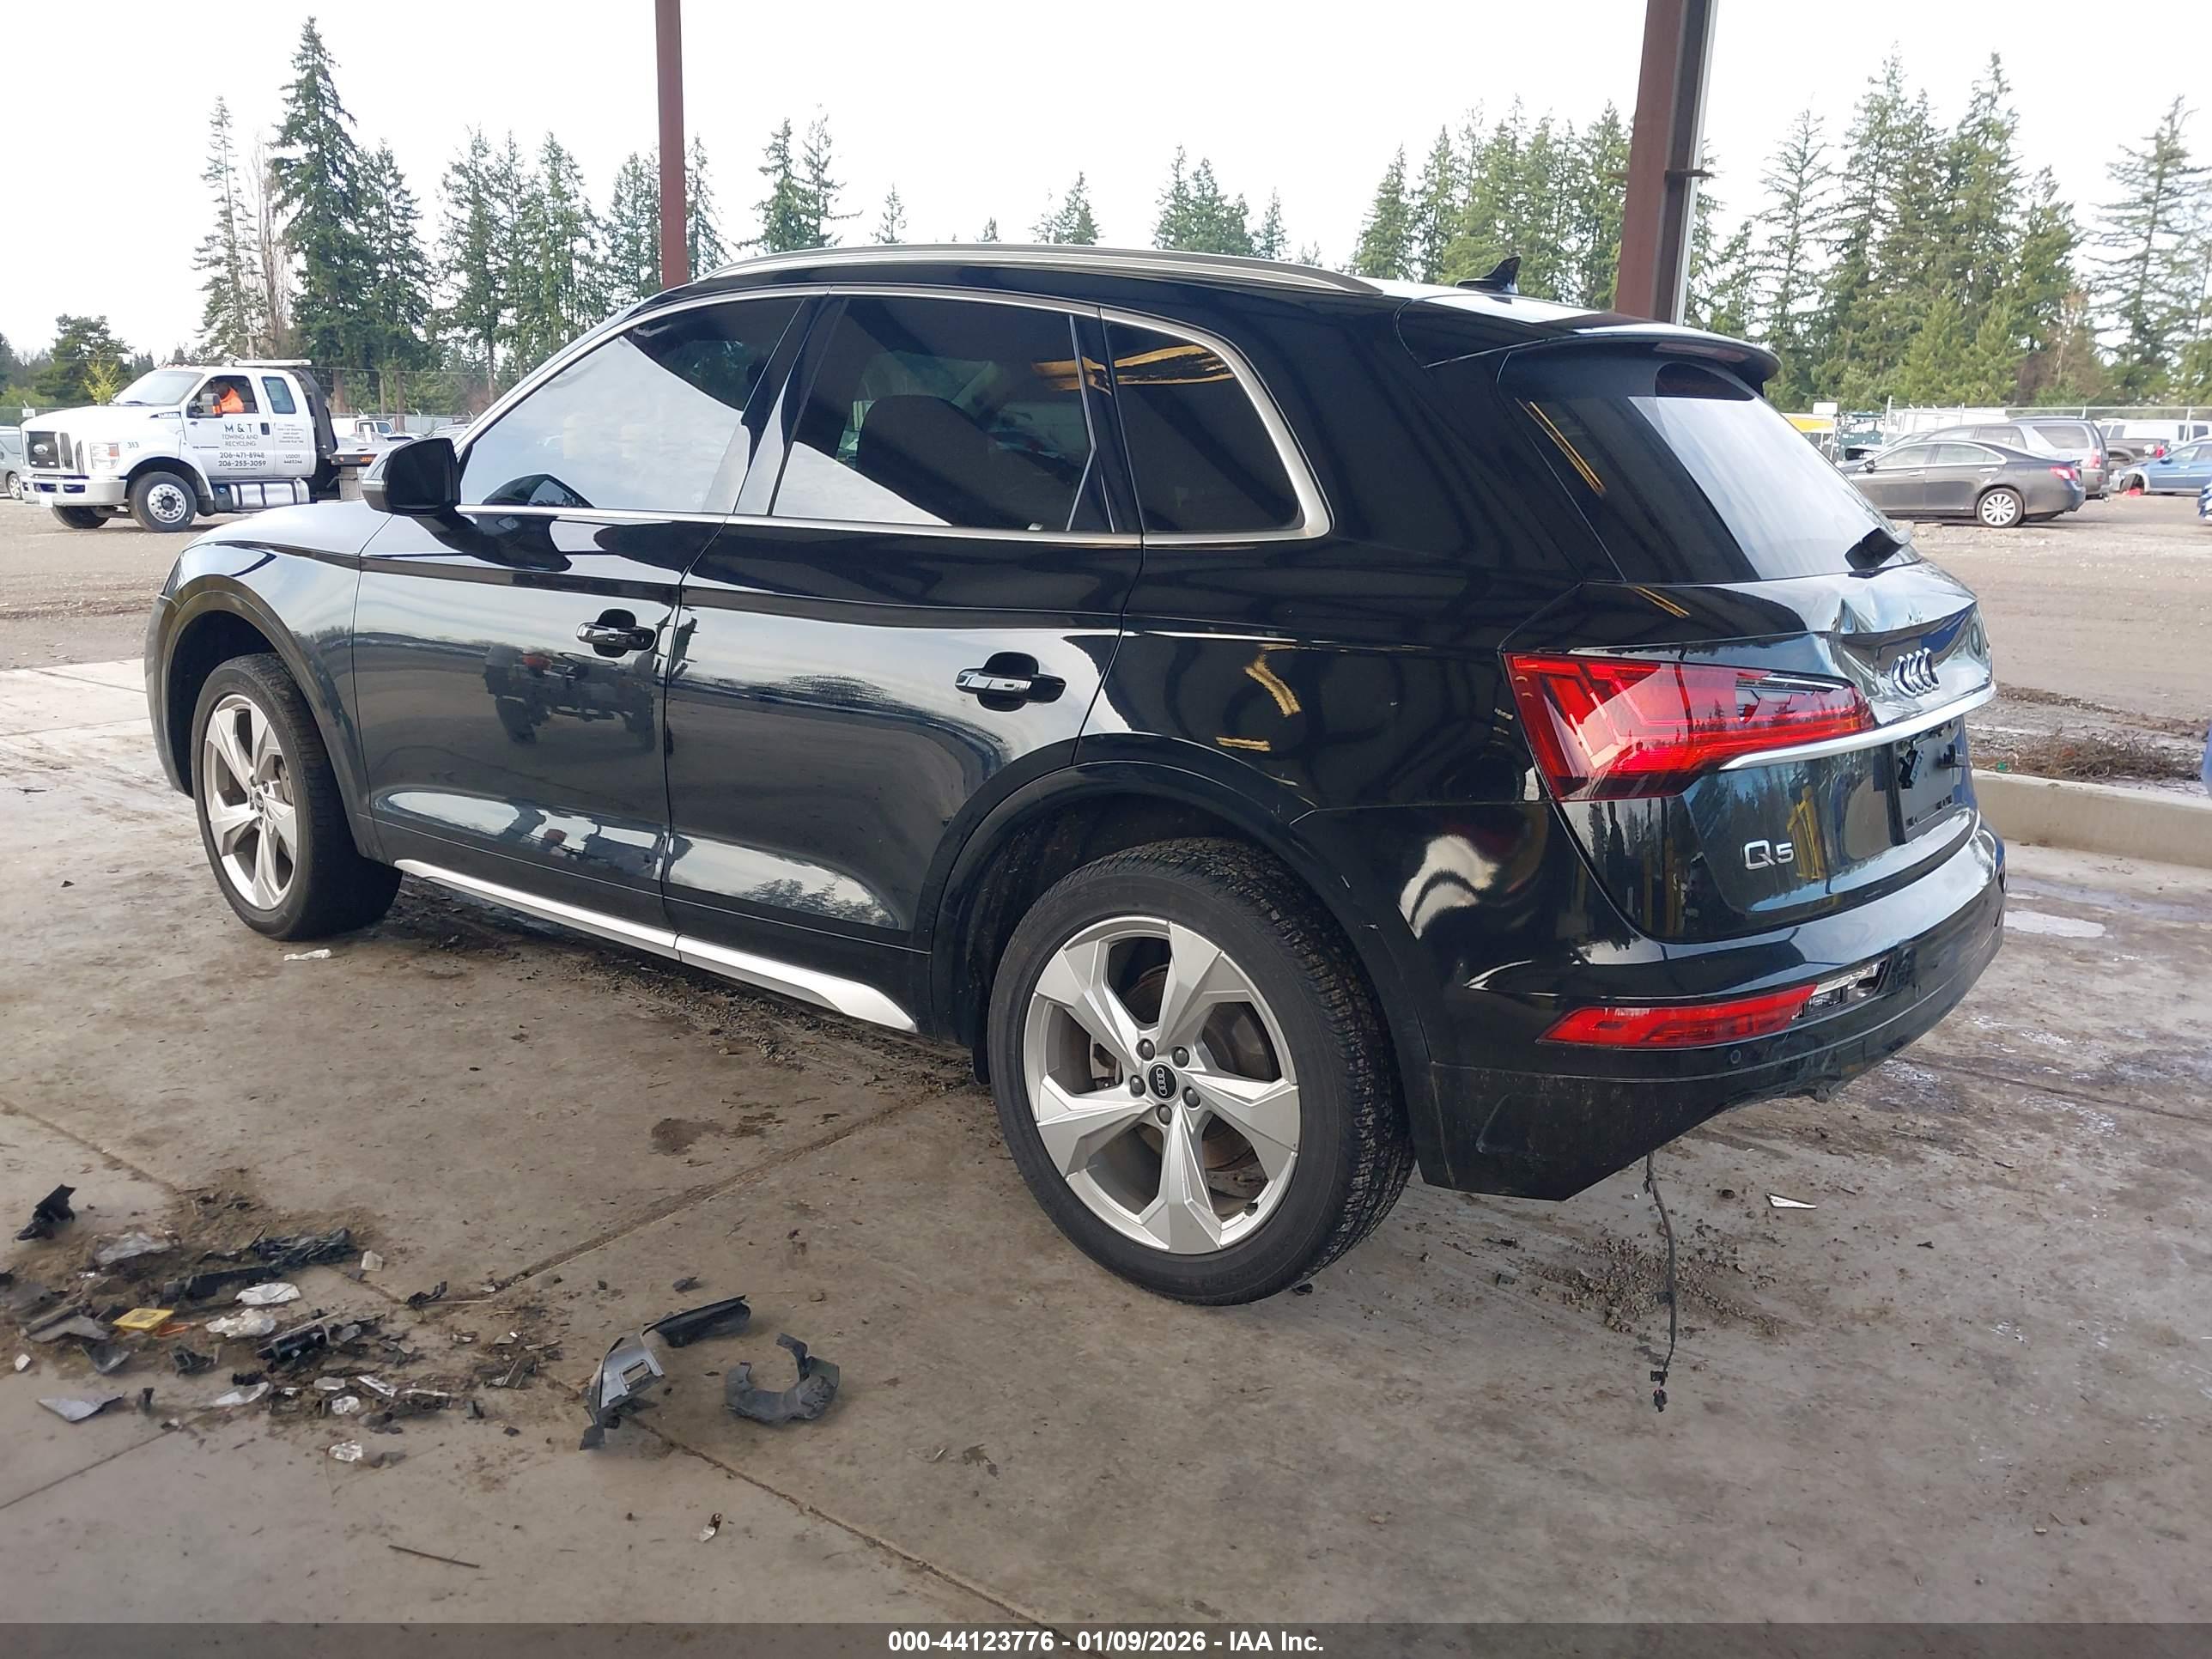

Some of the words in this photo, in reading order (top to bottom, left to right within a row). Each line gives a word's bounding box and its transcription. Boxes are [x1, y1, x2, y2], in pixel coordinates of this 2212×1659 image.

[224, 423, 234, 433] M
[237, 423, 245, 433] &
[246, 423, 253, 433] T
[1744, 839, 1795, 871] Q5
